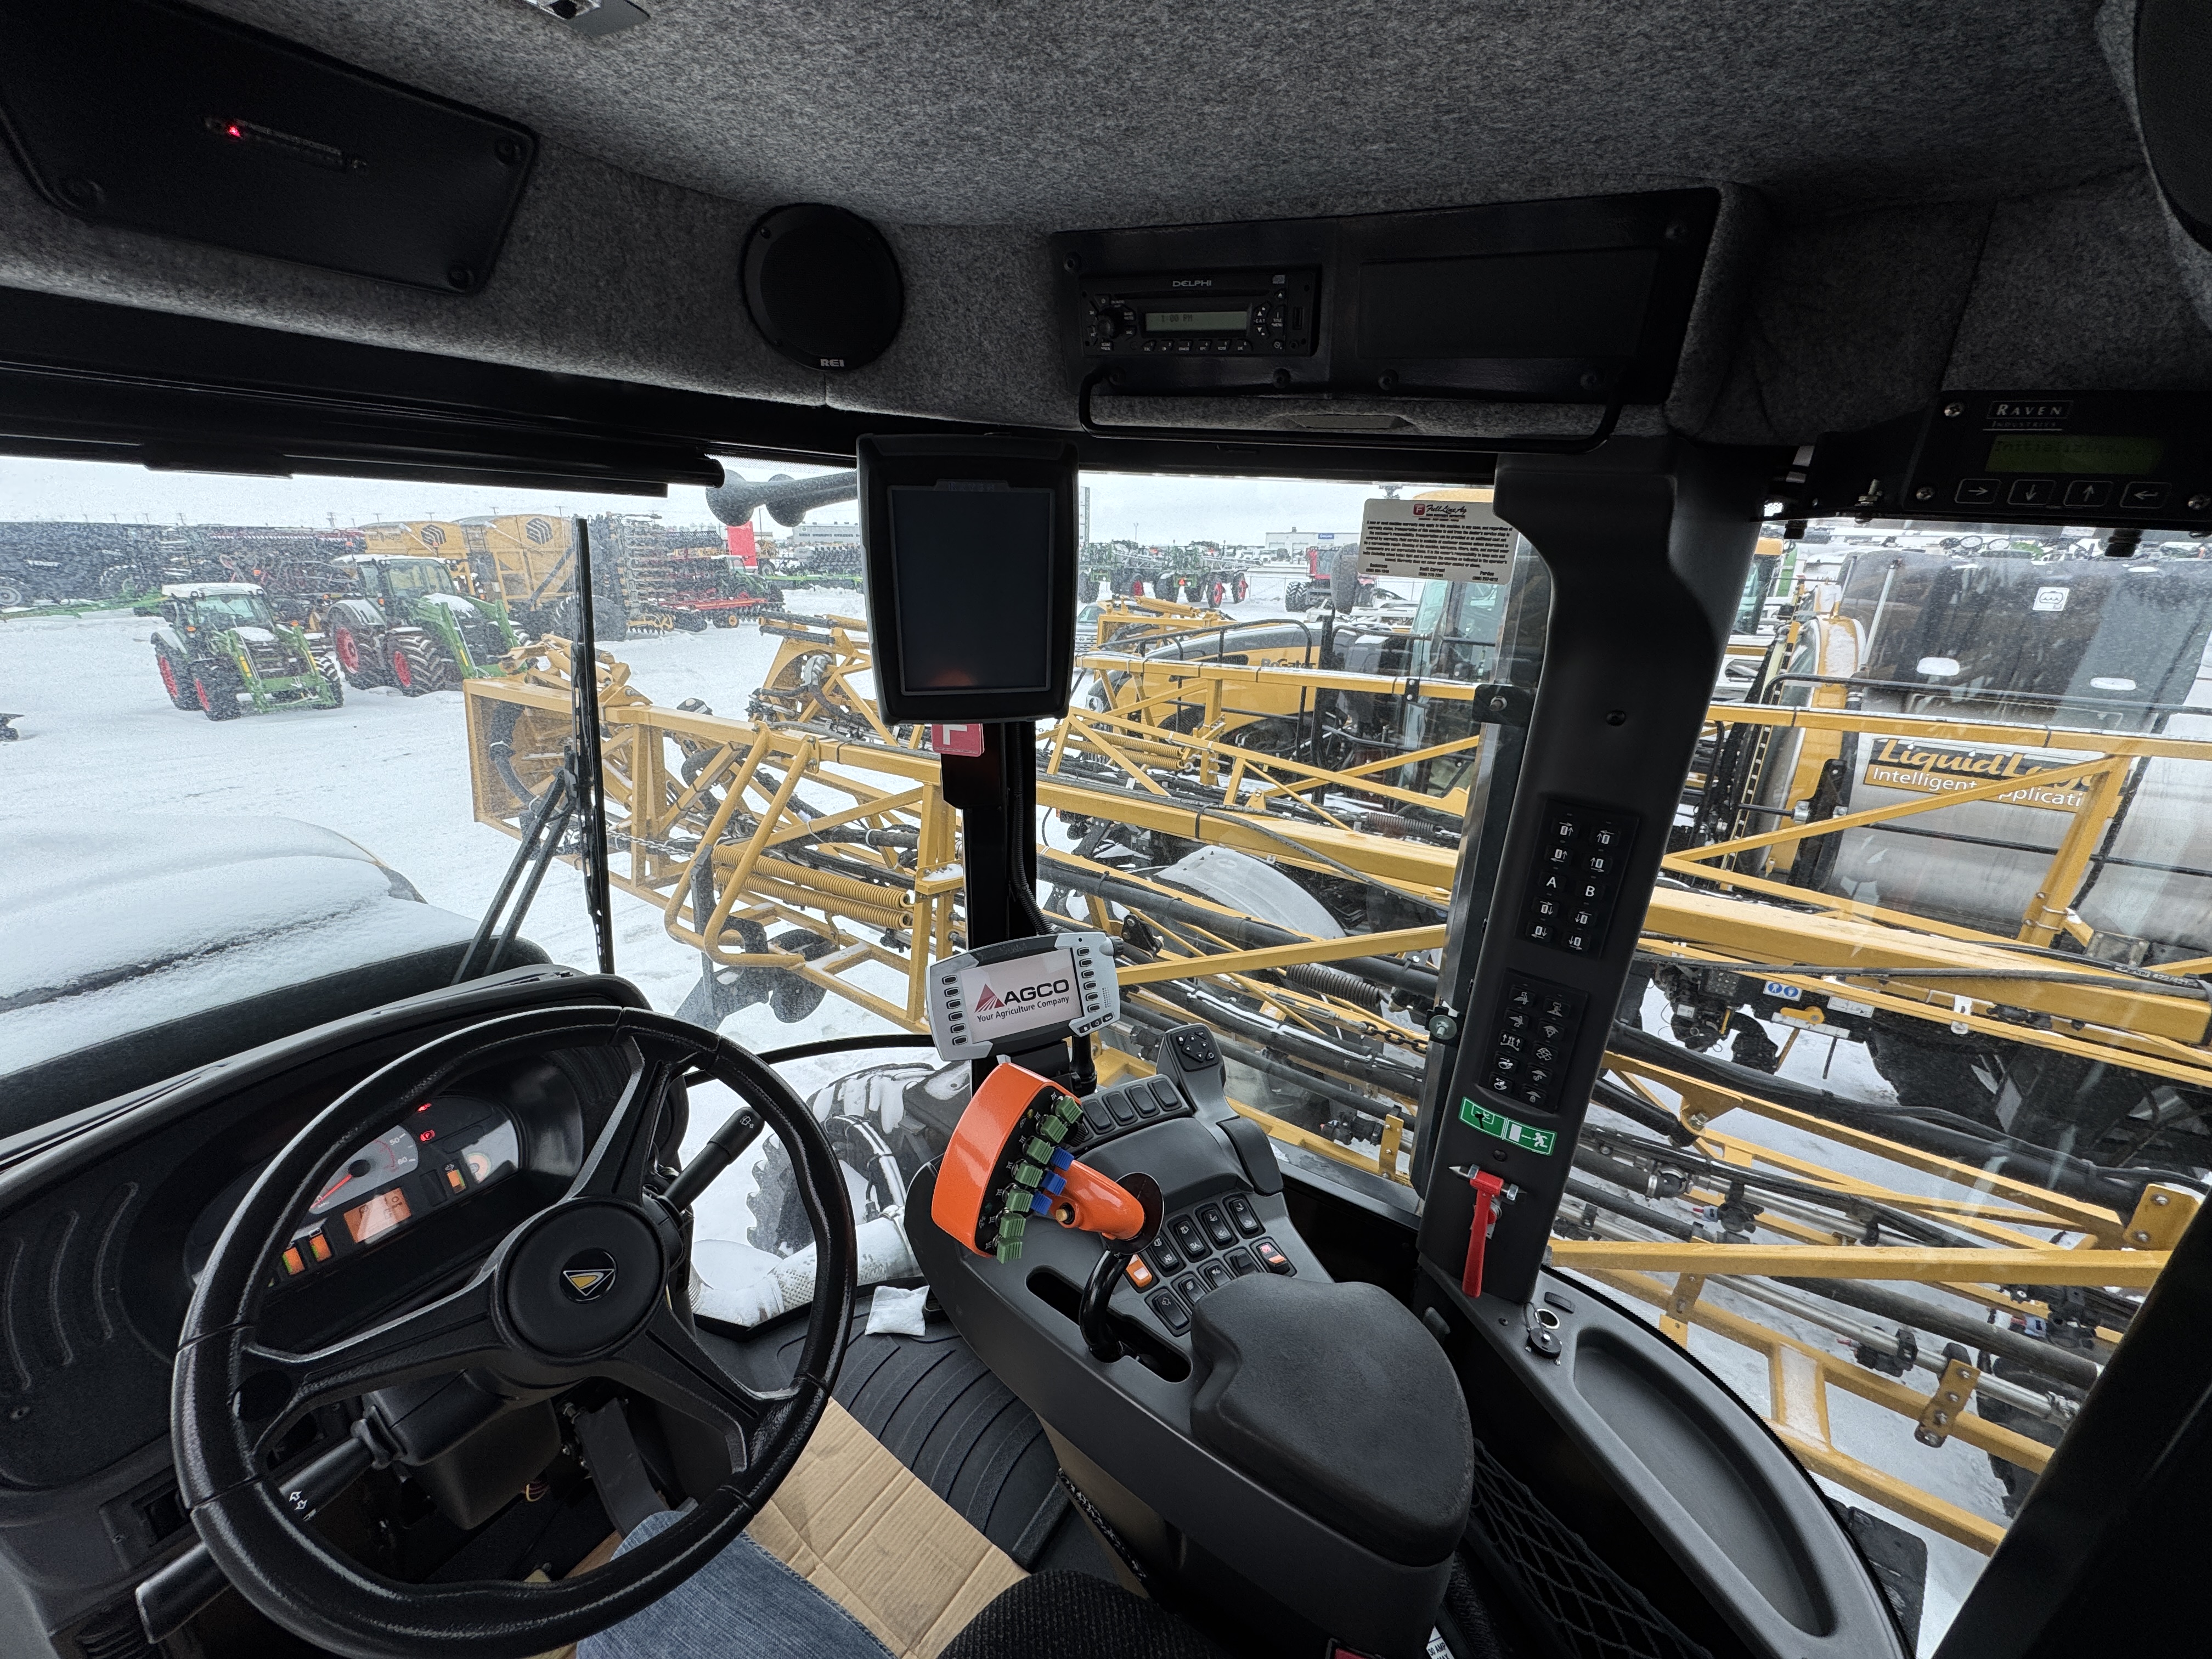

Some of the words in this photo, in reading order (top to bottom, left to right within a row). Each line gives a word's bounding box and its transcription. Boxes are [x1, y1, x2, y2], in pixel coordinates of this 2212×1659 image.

[820, 357, 846, 368] REI
[1995, 404, 2063, 416] RAVEN
[1873, 768, 1978, 792] Intelligent
[1545, 876, 1557, 888] A
[1585, 885, 1595, 897] B
[1003, 979, 1069, 1006] AGCO
[977, 1013, 994, 1023] Your
[995, 1003, 1036, 1020] Agriculture
[1037, 995, 1070, 1009] Company
[389, 1137, 400, 1146] 50
[1434, 1642, 1446, 1654] AMP
